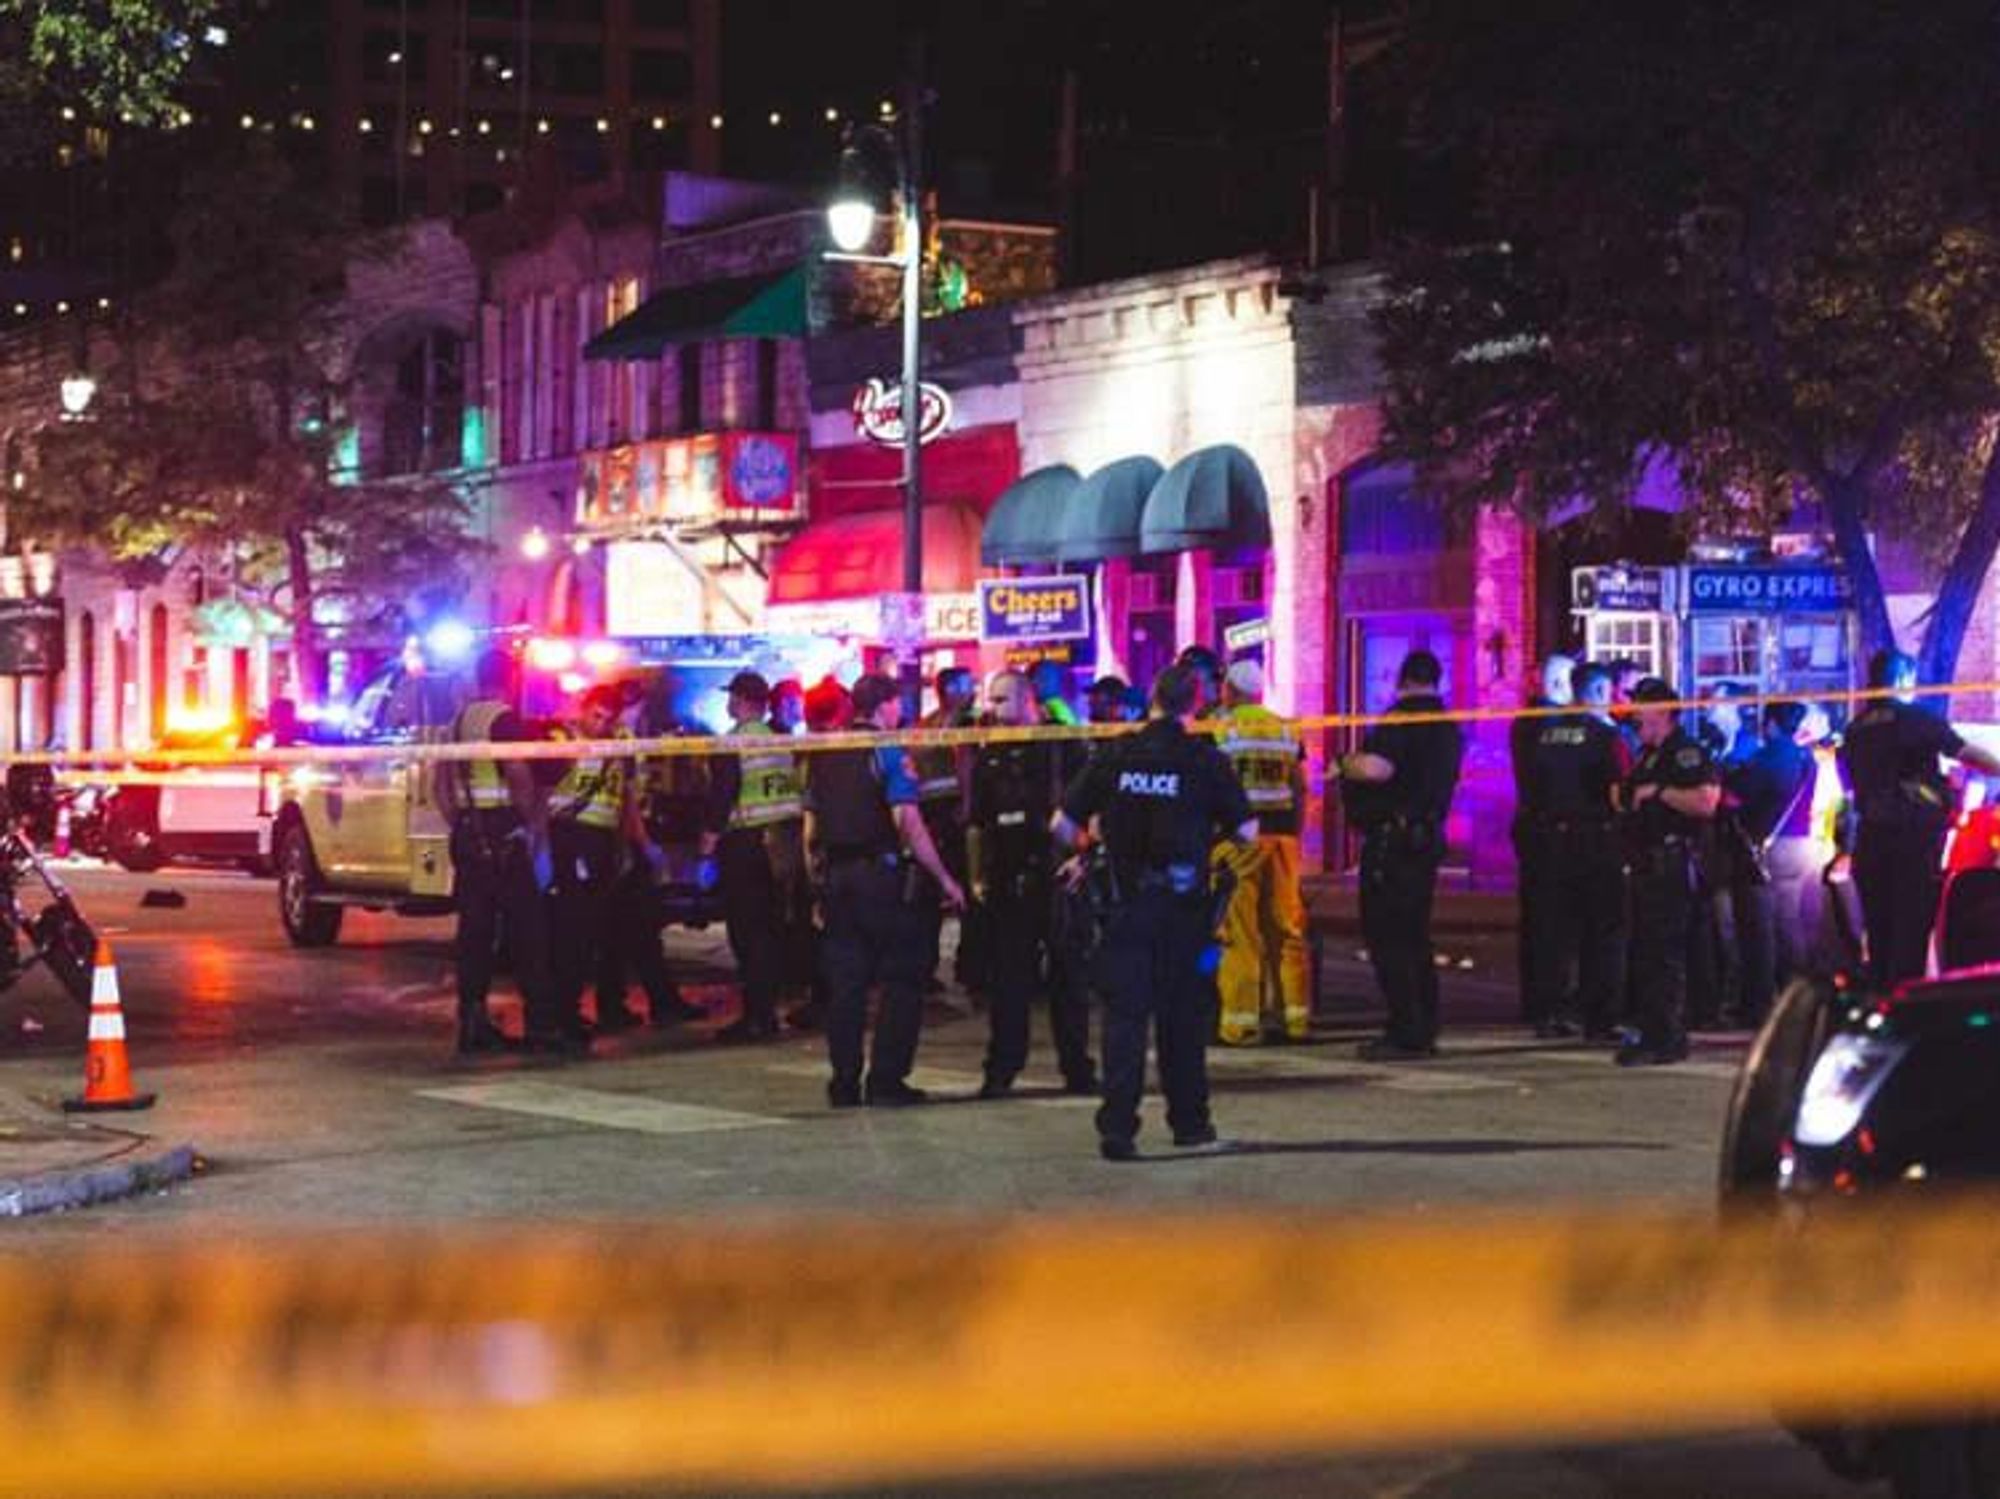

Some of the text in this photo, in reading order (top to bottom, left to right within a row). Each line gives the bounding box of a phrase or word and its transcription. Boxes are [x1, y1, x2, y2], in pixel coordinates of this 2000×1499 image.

[1694, 575, 1762, 598] GYRO
[989, 587, 1078, 614] Cheers
[1118, 772, 1180, 796] POLICE
